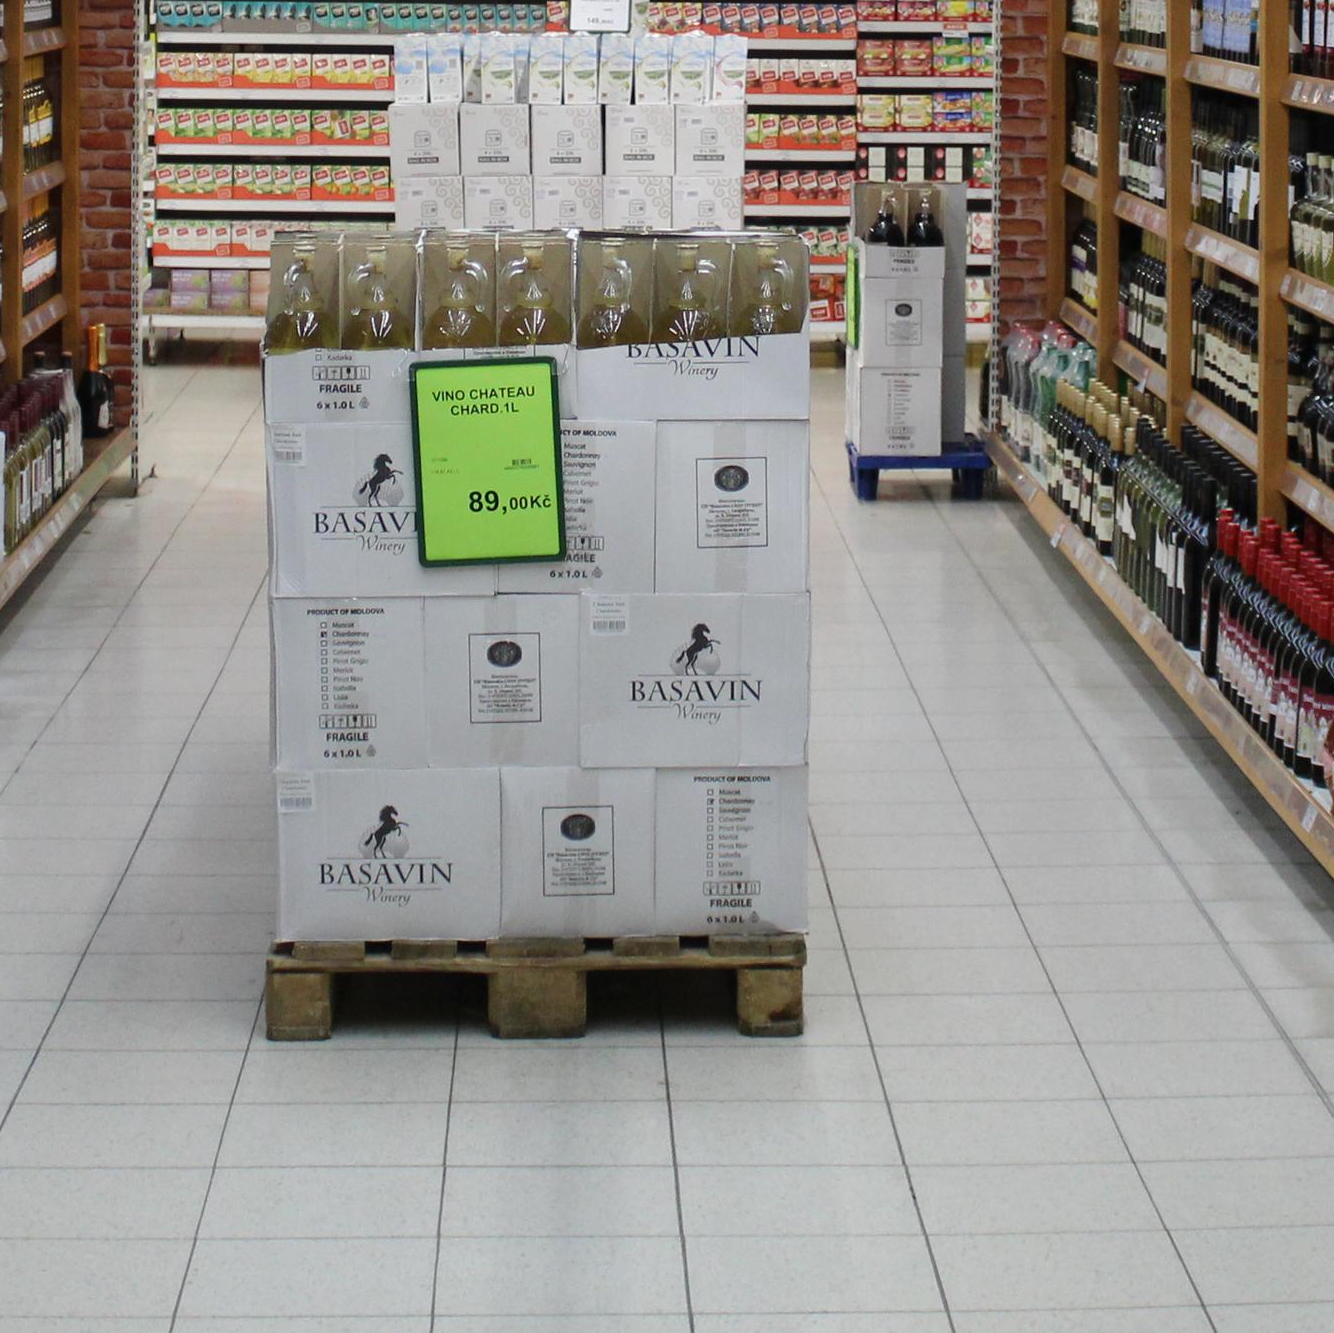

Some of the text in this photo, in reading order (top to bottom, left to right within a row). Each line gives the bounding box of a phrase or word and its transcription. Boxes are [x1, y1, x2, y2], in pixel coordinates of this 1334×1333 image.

[668, 359, 719, 380] Winery
[319, 383, 363, 394] FRAGILE
[432, 386, 536, 402] VINO CHATEAU
[315, 511, 417, 534] BASAVI
[359, 535, 407, 555] Winery
[566, 553, 596, 563] AGILE
[307, 608, 338, 616] PRODUCT
[350, 608, 385, 616] MOLDOVA
[629, 679, 763, 702] BASAVIN
[671, 702, 722, 725] Winery
[326, 731, 369, 742] FRAGILE
[693, 775, 725, 783] PRODUCT
[737, 775, 771, 783] MOLDOVA
[317, 862, 453, 885] BASAVIN
[365, 886, 411, 907] Winery
[710, 898, 753, 908] FRAGILE
